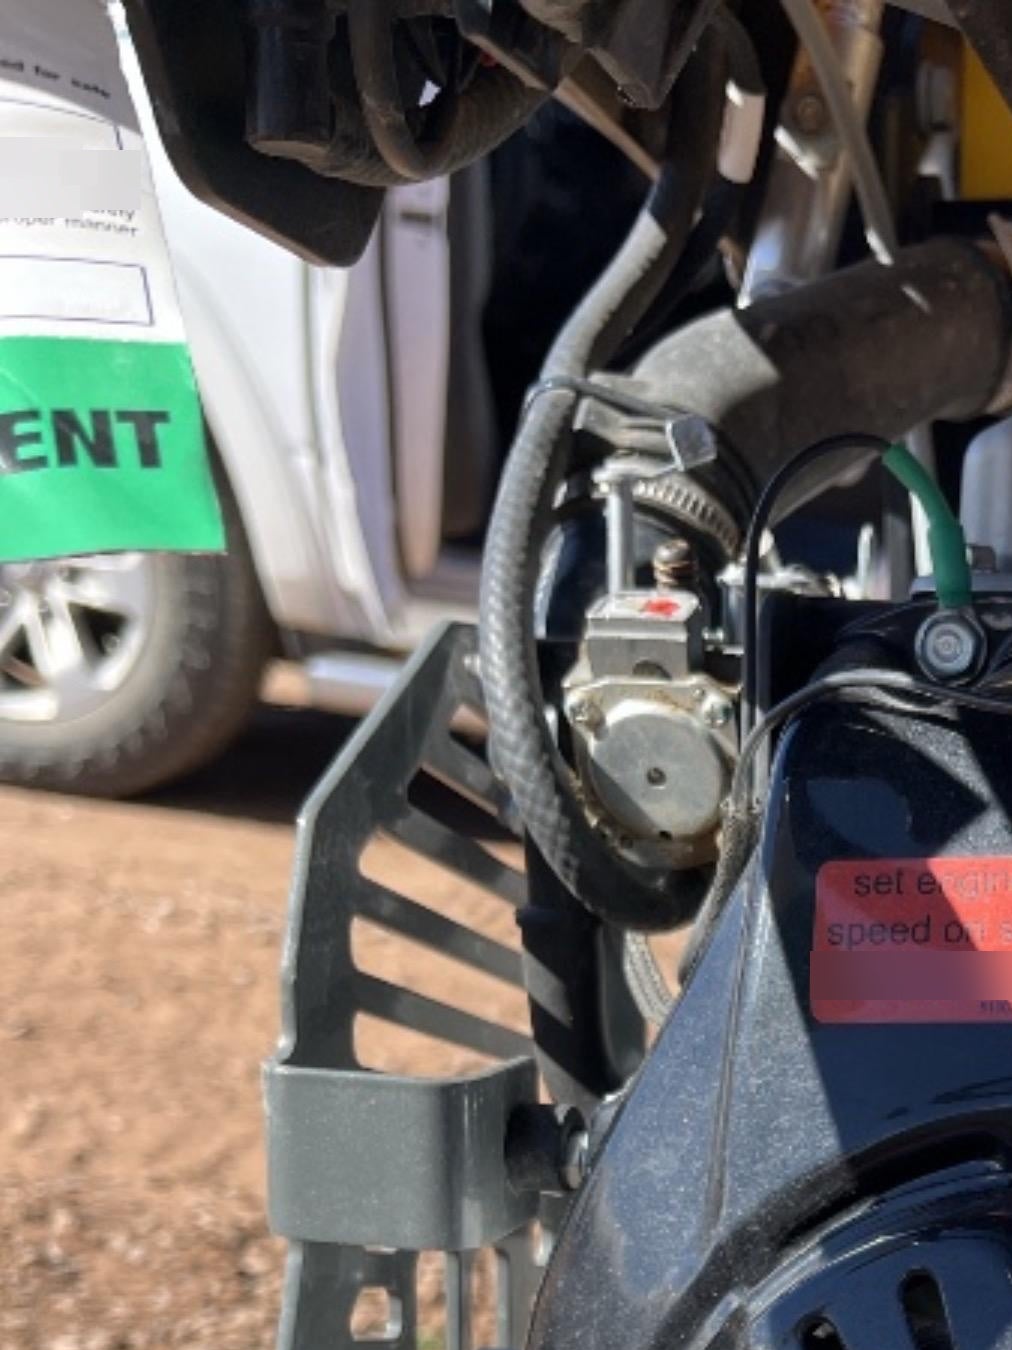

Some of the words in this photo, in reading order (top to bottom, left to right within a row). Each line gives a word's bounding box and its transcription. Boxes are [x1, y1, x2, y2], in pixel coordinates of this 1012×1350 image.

[0, 409, 170, 472] ENT
[854, 868, 905, 896] set
[826, 915, 932, 951] speed
[943, 922, 986, 945] on
